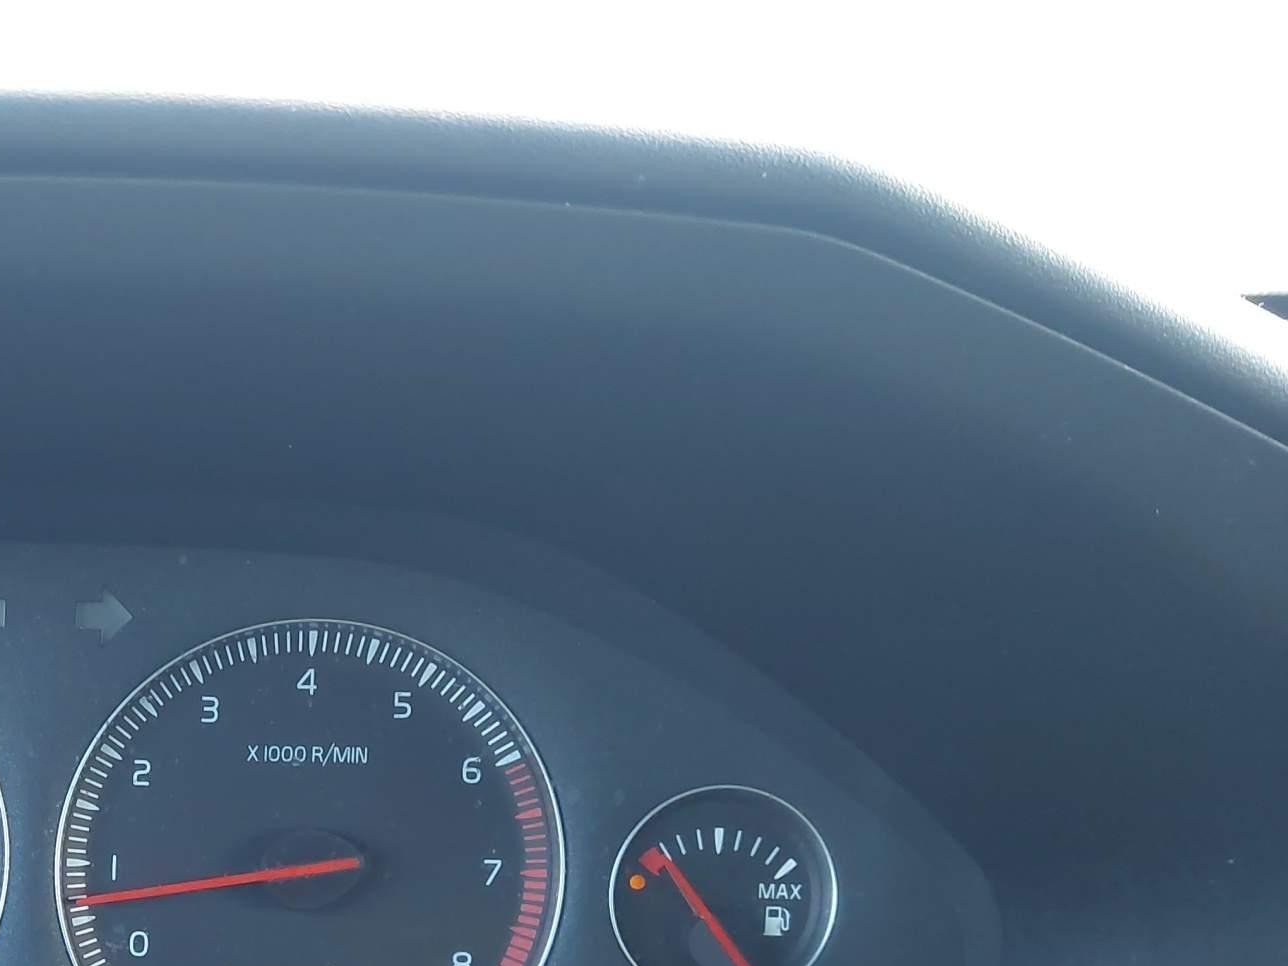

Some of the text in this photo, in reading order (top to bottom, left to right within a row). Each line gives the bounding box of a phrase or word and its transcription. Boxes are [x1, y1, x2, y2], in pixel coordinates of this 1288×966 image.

[296, 669, 317, 694] 4
[201, 696, 219, 722] 3
[394, 692, 412, 718] 5
[246, 746, 368, 764] X 1000 R/MIN
[133, 760, 151, 786] 2
[462, 758, 482, 783] 6
[484, 860, 502, 886] 7
[758, 883, 802, 900] MAX
[129, 931, 148, 956] 0
